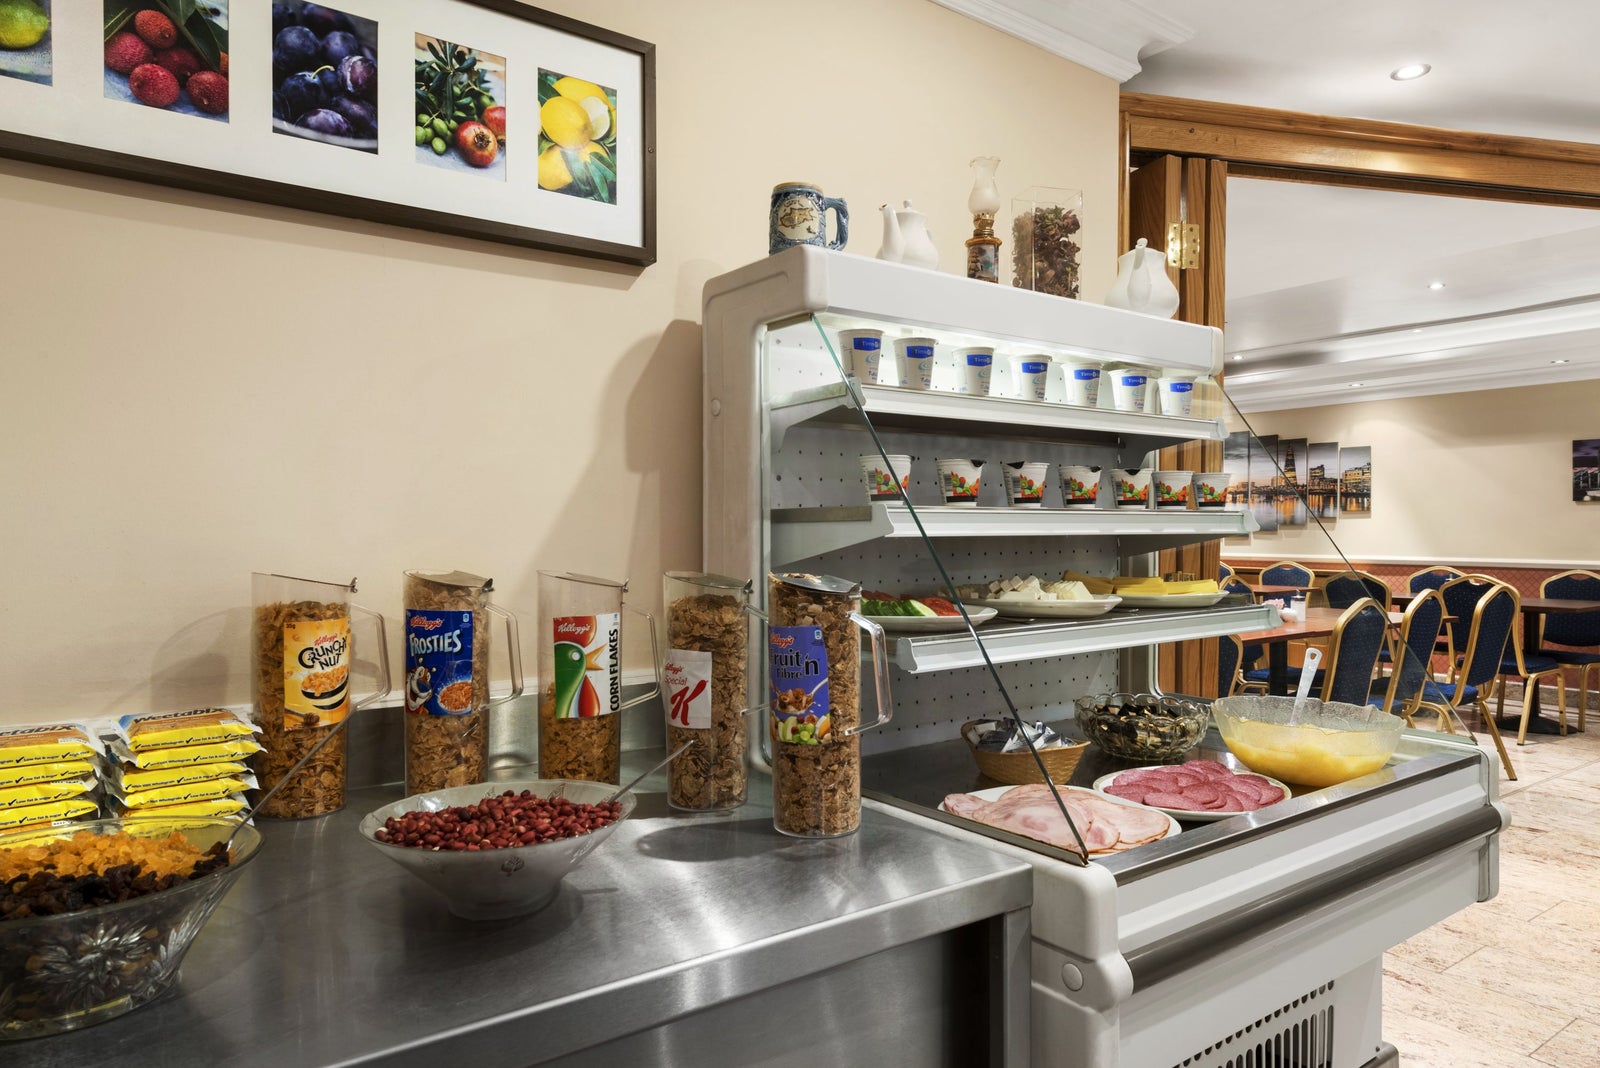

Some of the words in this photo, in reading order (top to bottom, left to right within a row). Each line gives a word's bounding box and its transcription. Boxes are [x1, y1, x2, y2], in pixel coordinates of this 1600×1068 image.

[410, 615, 443, 630] Kellogg's
[558, 622, 591, 635] Kellogg's
[298, 636, 348, 669] CRUNCHY
[409, 629, 462, 657] FROSTIES
[608, 628, 619, 675] FLAKES
[318, 652, 342, 670] NUT
[609, 675, 620, 712] CORN
[670, 679, 708, 727] K
[134, 708, 226, 723] Weetabix
